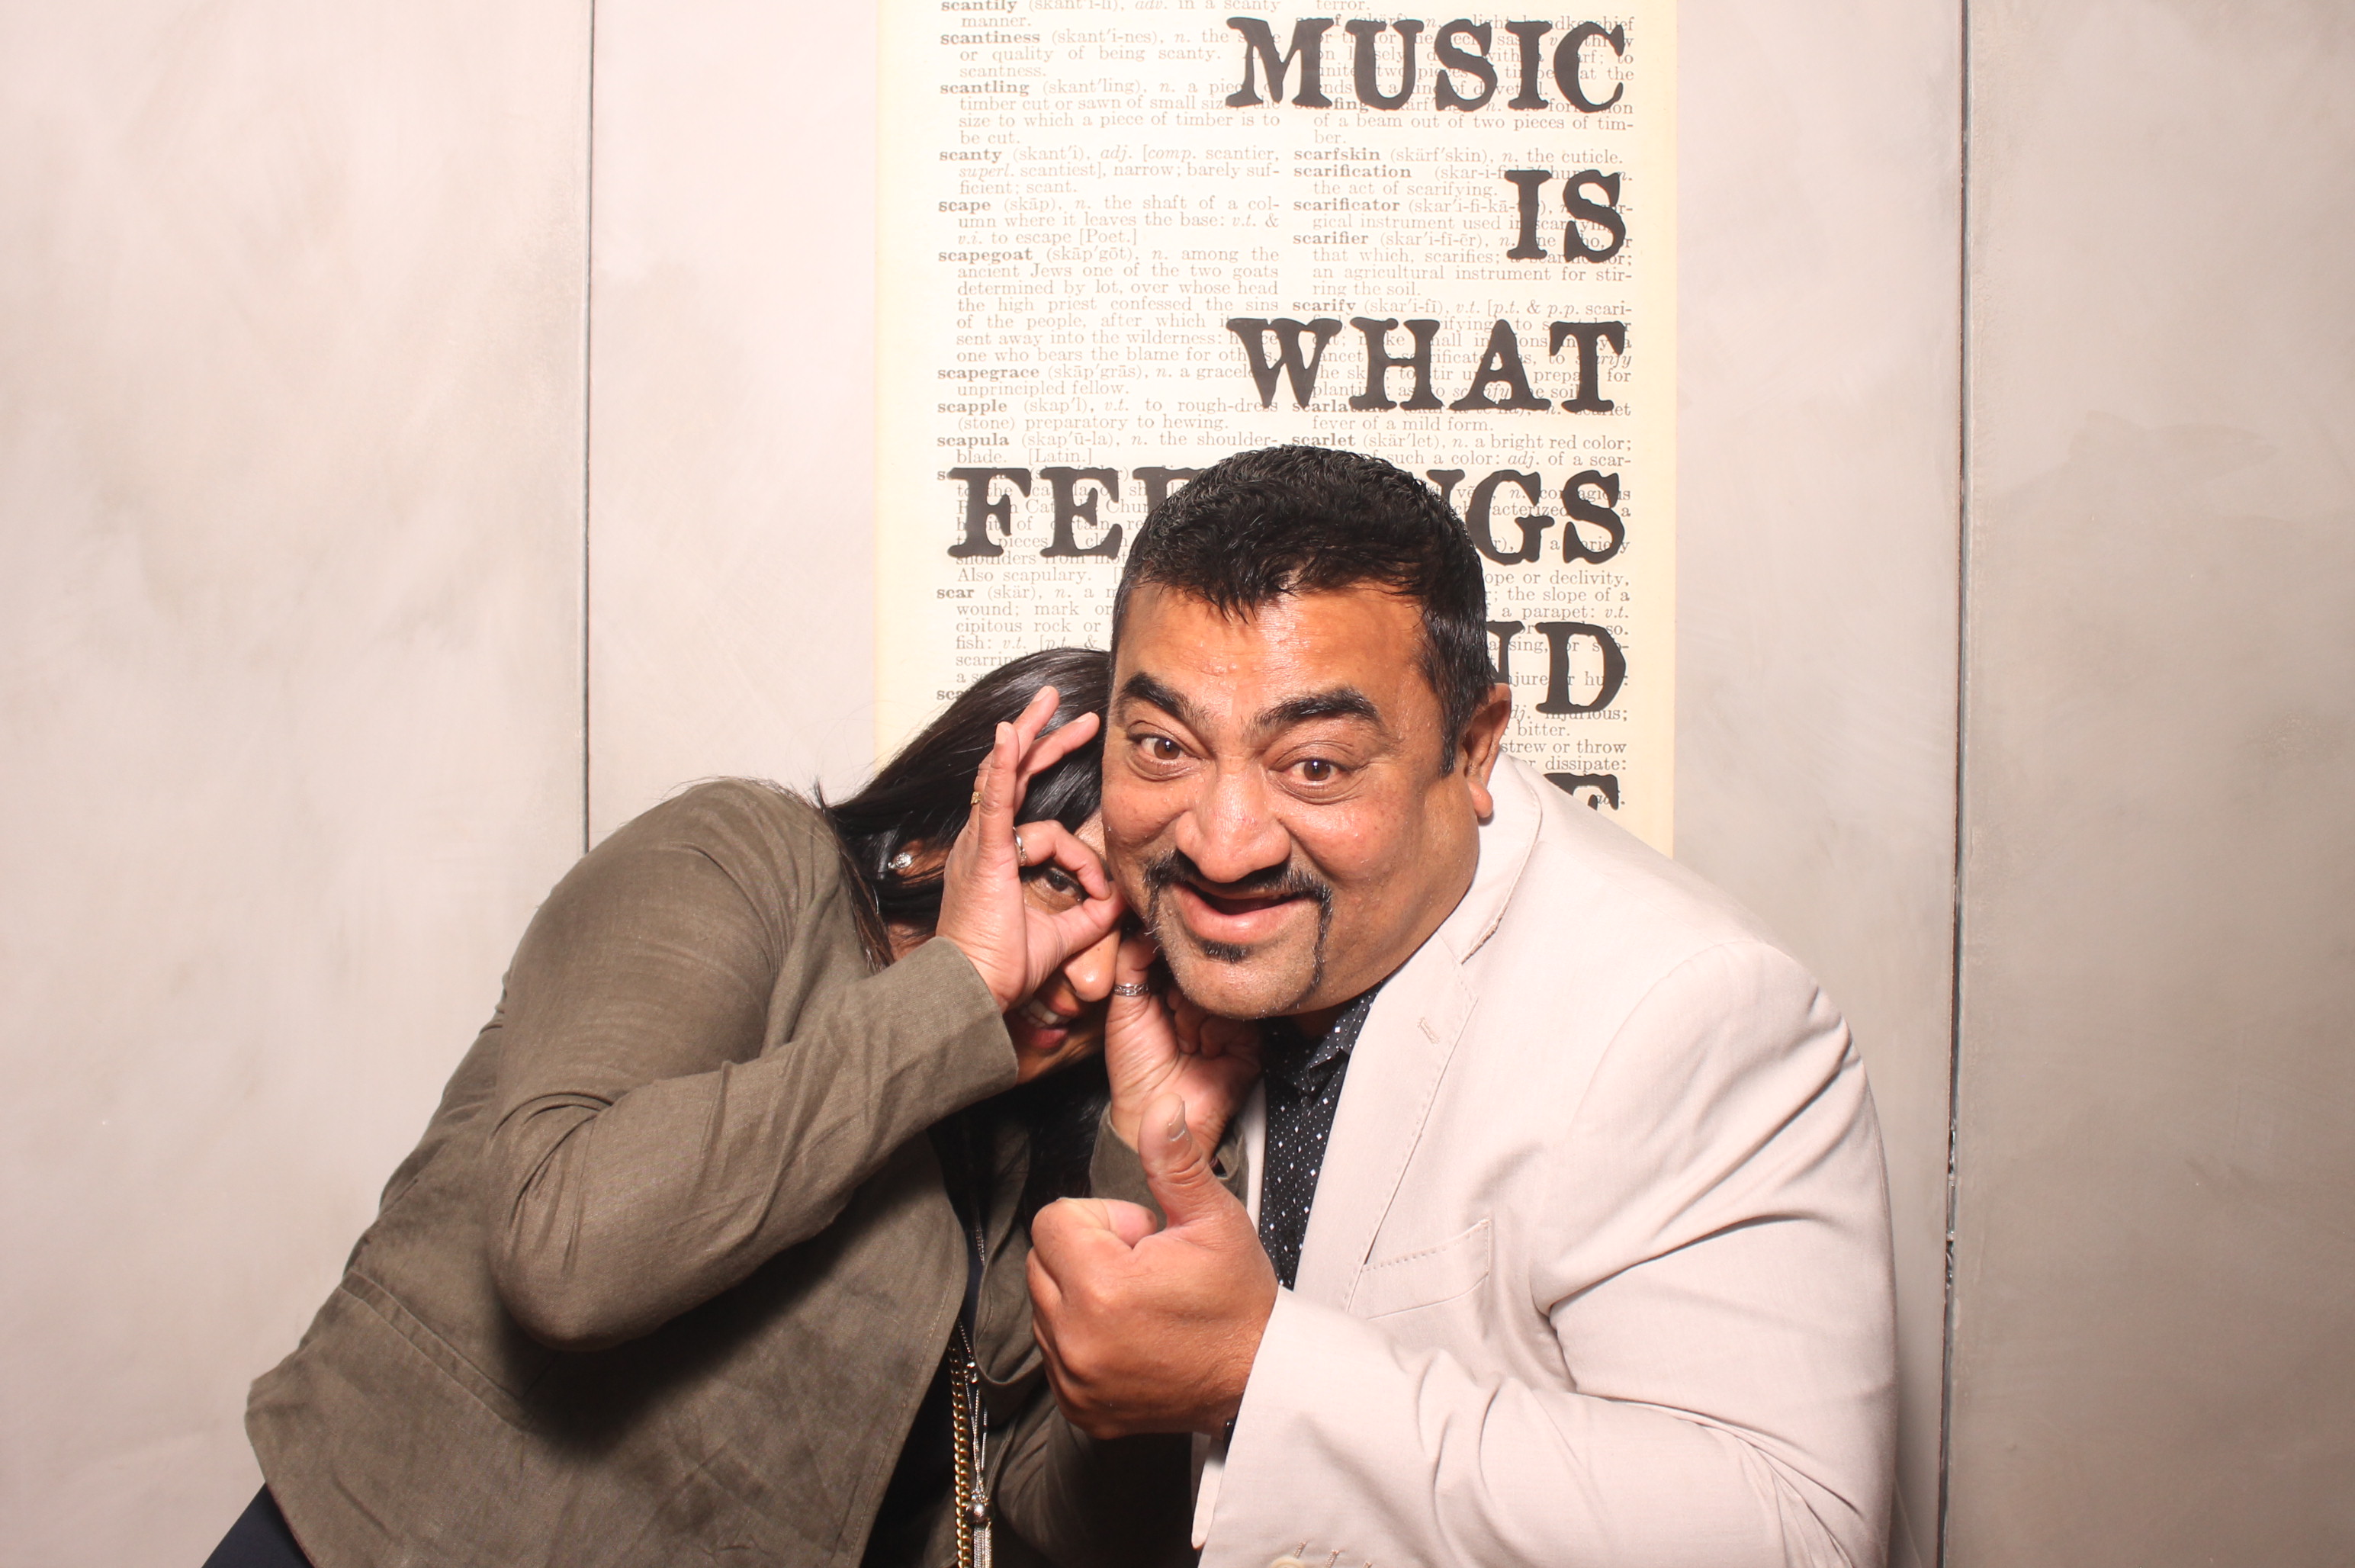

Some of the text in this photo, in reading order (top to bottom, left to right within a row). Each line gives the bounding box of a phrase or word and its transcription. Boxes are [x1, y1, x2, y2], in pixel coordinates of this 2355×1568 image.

[940, 0, 1280, 14] scantily scanty
[1316, 0, 1370, 11] terror.
[961, 17, 1031, 27] manner.
[940, 29, 1229, 44] scantiness the
[991, 46, 1221, 63] quality being scanty.
[959, 65, 1046, 78] scantness.
[1225, 16, 1626, 113] MUSIC
[940, 79, 1030, 97] scantling
[959, 95, 1196, 111] timber cut sawn small
[959, 112, 1234, 128] size which piece timber
[1357, 113, 1634, 132] beam out two pieces tim-
[987, 130, 1020, 143] cut.
[1315, 130, 1346, 144] ber.
[939, 147, 1003, 163] scanty
[1205, 147, 1279, 163] scantier,
[1293, 146, 1624, 164] scarfskin the cuticle.
[1020, 163, 1107, 181] scantiest],
[1187, 162, 1241, 179] barely
[1246, 163, 1280, 178] suf-
[1293, 163, 1412, 178] scarification
[1026, 179, 1077, 192] scant.
[1314, 180, 1498, 199] the act scarifying.
[937, 195, 1280, 214] scape the shaft col-
[1293, 197, 1401, 210] scarificator
[958, 217, 997, 227] umn
[1004, 214, 1055, 227] where
[1085, 212, 1137, 226] leaves
[1145, 212, 1173, 226] the
[1312, 214, 1502, 230] gical instrument used
[1505, 169, 1626, 263] IS
[1015, 233, 1071, 247] escape
[1292, 230, 1370, 245] scarifier
[937, 247, 1280, 264] scapegoat among the
[1312, 247, 1348, 261] that
[1359, 249, 1415, 266] which,
[957, 262, 1279, 281] ancient Jews one the two goats
[1312, 265, 1633, 282] an agricultural instrument for stir-
[957, 279, 1279, 297] determined by lot, over whose head
[1312, 281, 1421, 298] ring the soil.
[958, 296, 1279, 315] the high priest confessed the sins
[1292, 297, 1633, 316] scarify scari-
[987, 313, 1206, 331] the people, after which
[956, 333, 992, 345] sent
[998, 335, 1043, 349] away
[1050, 331, 1084, 344] into
[1091, 329, 1120, 344] the
[956, 346, 1211, 362] one who bears the blame for
[1226, 317, 1626, 413] WHAT
[937, 368, 1040, 382] scapegrace
[957, 380, 1129, 398] unprincipled fellow.
[937, 398, 1007, 415] scapple
[1024, 416, 1129, 432] preparatory
[1162, 415, 1229, 432] hewing.
[1312, 416, 1494, 432] fever mild form.
[937, 432, 1281, 449] scapula the shoulder-
[1289, 432, 1357, 445] scarlet
[1491, 435, 1544, 452] bright
[1548, 435, 1578, 449] red
[956, 450, 1007, 464] blade.
[1386, 450, 1425, 464] such
[1589, 456, 1632, 467] scar-
[957, 567, 1092, 584] Also scapulary.
[1549, 570, 1630, 588] declivity,
[936, 588, 975, 599] scar
[1506, 587, 1587, 605] the slope
[1034, 601, 1080, 615] mark
[956, 618, 1072, 635] cipitous rock
[1517, 723, 1571, 737] bitter.
[1499, 739, 1627, 753] strew throw
